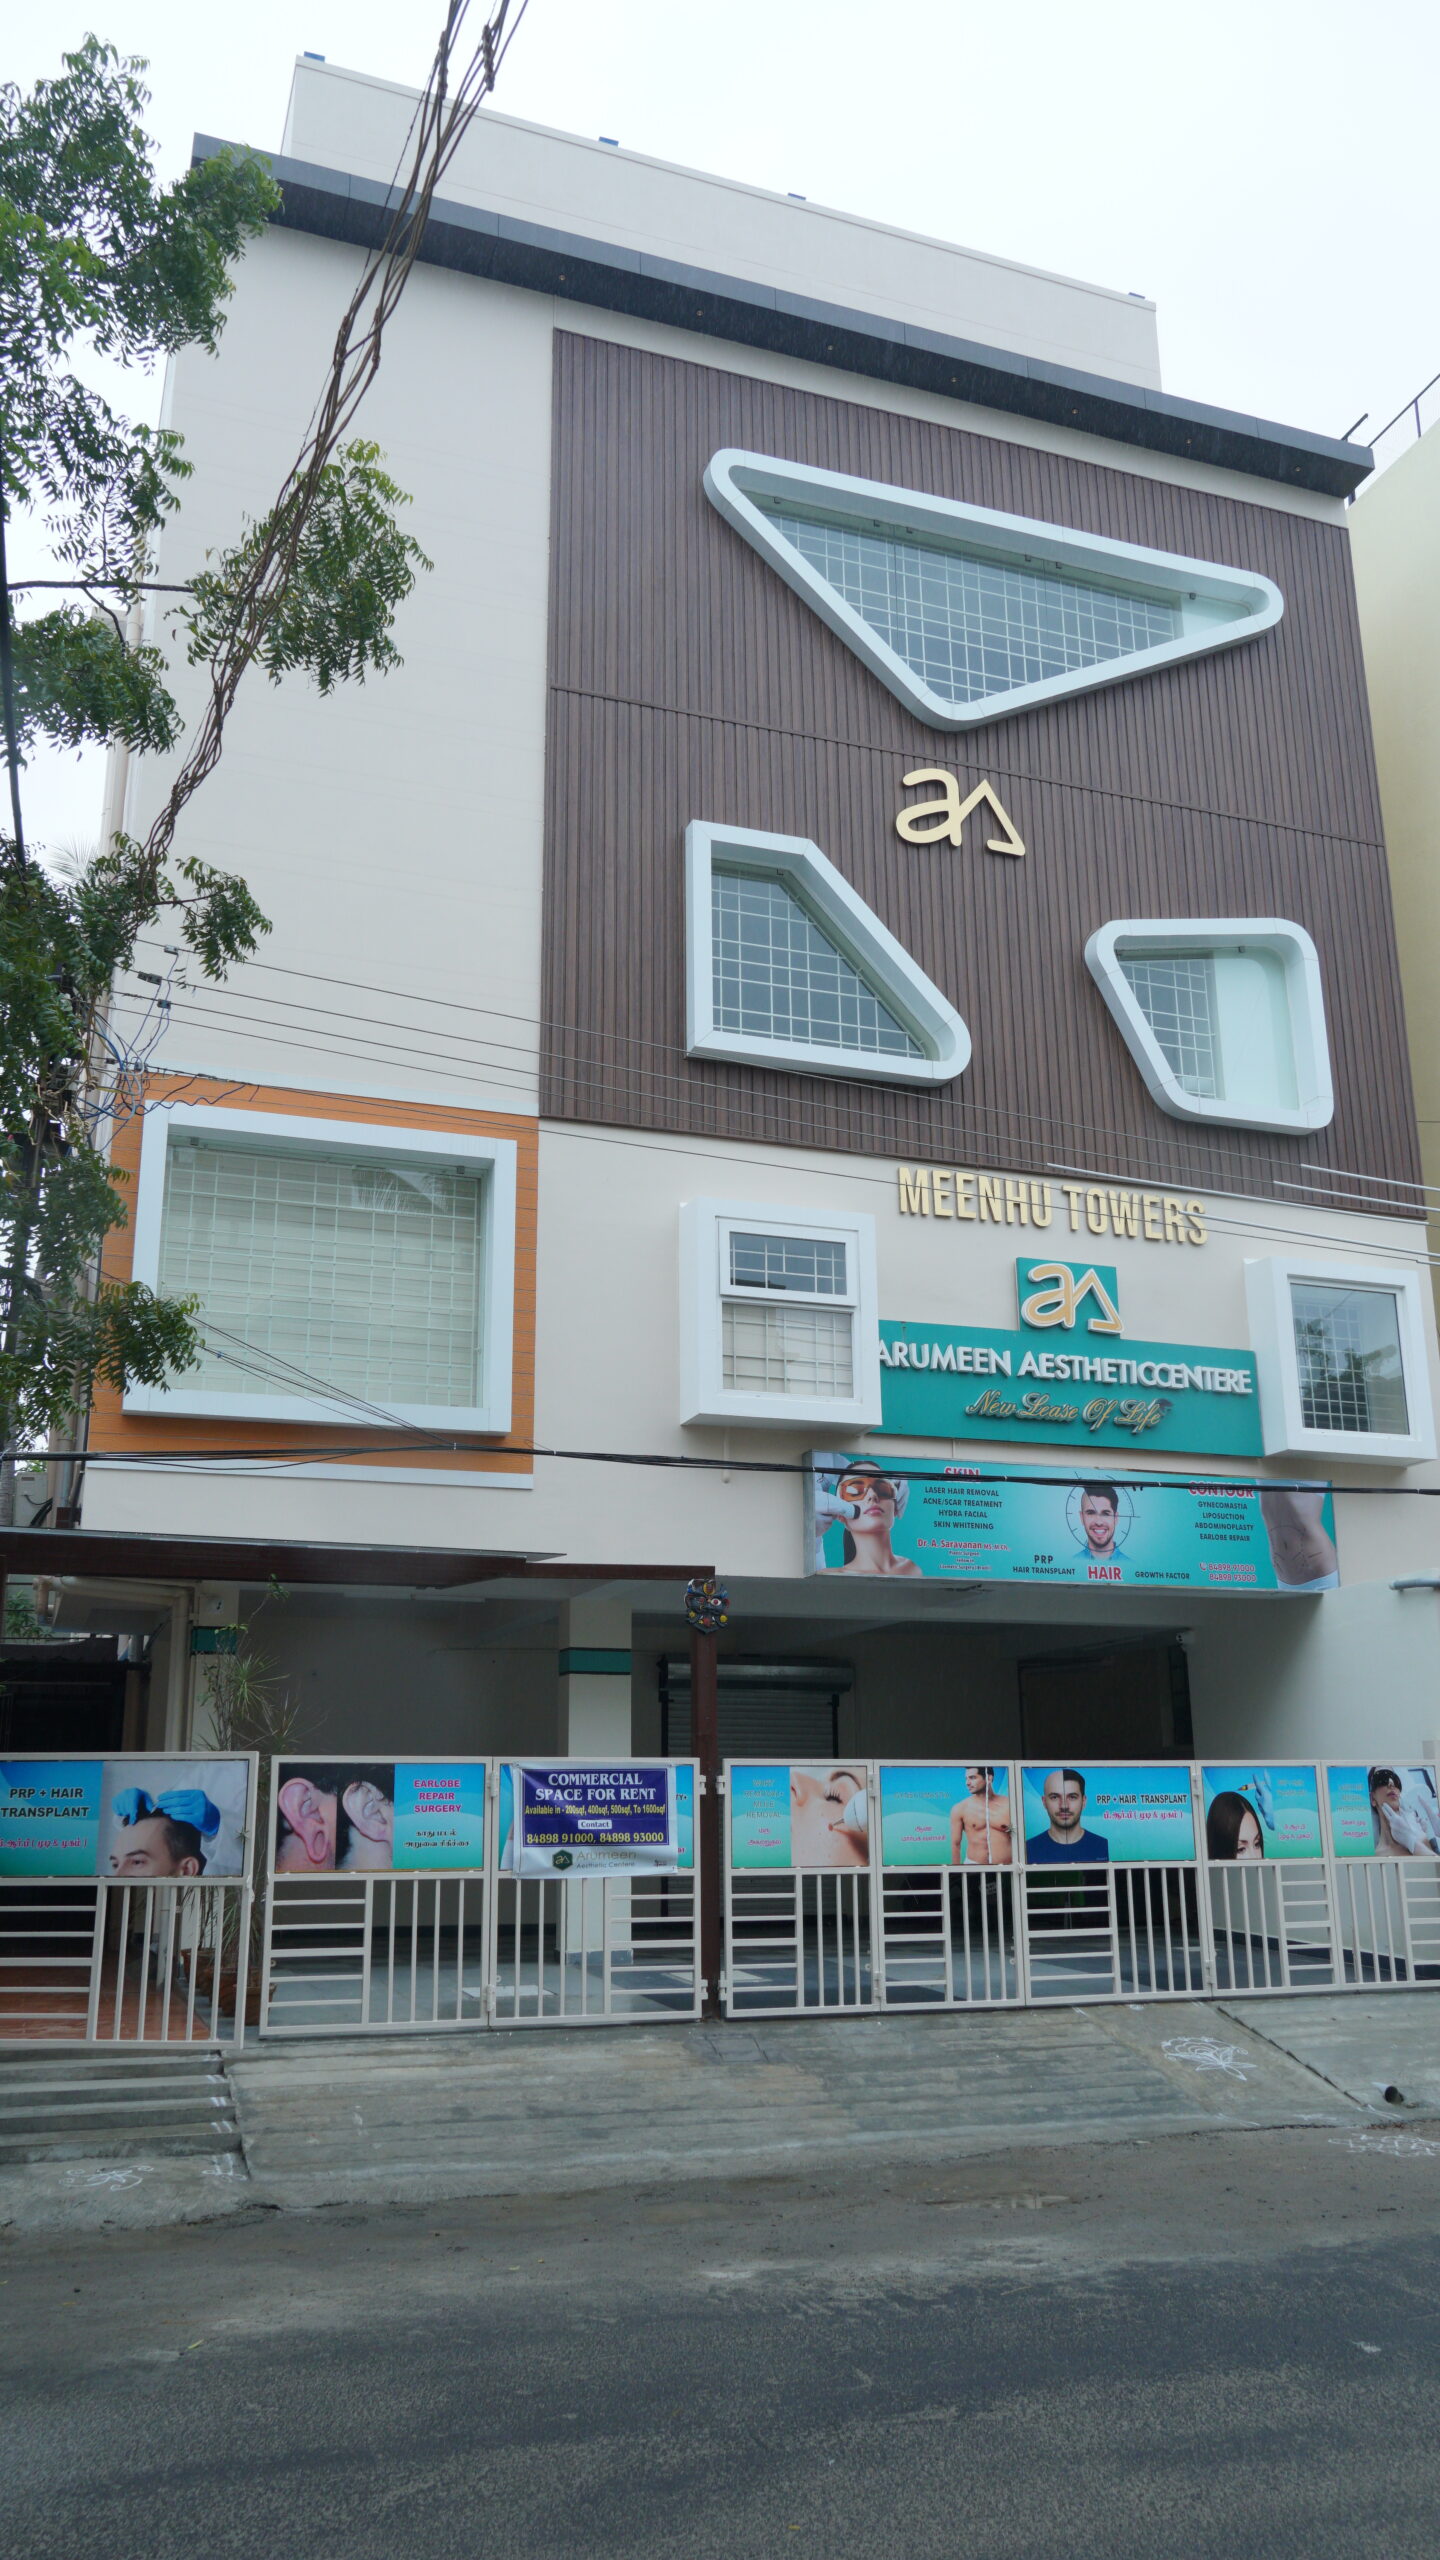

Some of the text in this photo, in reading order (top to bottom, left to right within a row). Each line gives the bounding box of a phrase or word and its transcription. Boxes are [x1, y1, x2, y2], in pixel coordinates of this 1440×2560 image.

[898, 1166, 1208, 1245] MEENHU TOWERS
[879, 1339, 1011, 1377] ARUMEEN
[965, 1389, 1161, 1433] New Lease Of Life
[925, 1486, 999, 1497] LASER HAIR REMOVAL
[1188, 1481, 1255, 1498] CONTOUR
[923, 1498, 1003, 1508] ACNE/SCAR TREATMENT
[1198, 1501, 1248, 1510] GYNECOMASTIA
[939, 1509, 962, 1517] HYDRA
[1202, 1512, 1245, 1520] LIPOSUCTION
[933, 1520, 994, 1530] SKIN WHITENING
[1195, 1522, 1254, 1531] ABDOMINOPLASTY
[1200, 1533, 1227, 1541] EARLOBE
[917, 1538, 928, 1547] Dr.
[940, 1540, 983, 1549] Saravanan
[1034, 1554, 1054, 1564] PRP
[1031, 1567, 1076, 1575] TRANSPLANT
[1087, 1565, 1122, 1581] HAIR
[1134, 1570, 1190, 1580] GROWTH FACTOR
[414, 1779, 461, 1788] EARLOBE
[548, 1773, 643, 1786] COMMERCIAL
[10, 1788, 36, 1799] PRP
[50, 1788, 84, 1799] HAIR
[419, 1792, 455, 1800] REPAIR
[535, 1787, 657, 1801] SPACE FOR RENT
[1097, 1795, 1111, 1804] PRP
[1119, 1795, 1137, 1804] HAIR
[1140, 1794, 1187, 1804] TRANSPLANT
[0, 1807, 90, 1818] TRANSPLANT
[414, 1805, 462, 1813] SURGERY
[525, 1805, 553, 1815] Available
[555, 1805, 561, 1814] in
[633, 1804, 641, 1814] To
[527, 1833, 559, 1844] 84898
[599, 1832, 631, 1843] 84898
[633, 1832, 664, 1842] 93000
